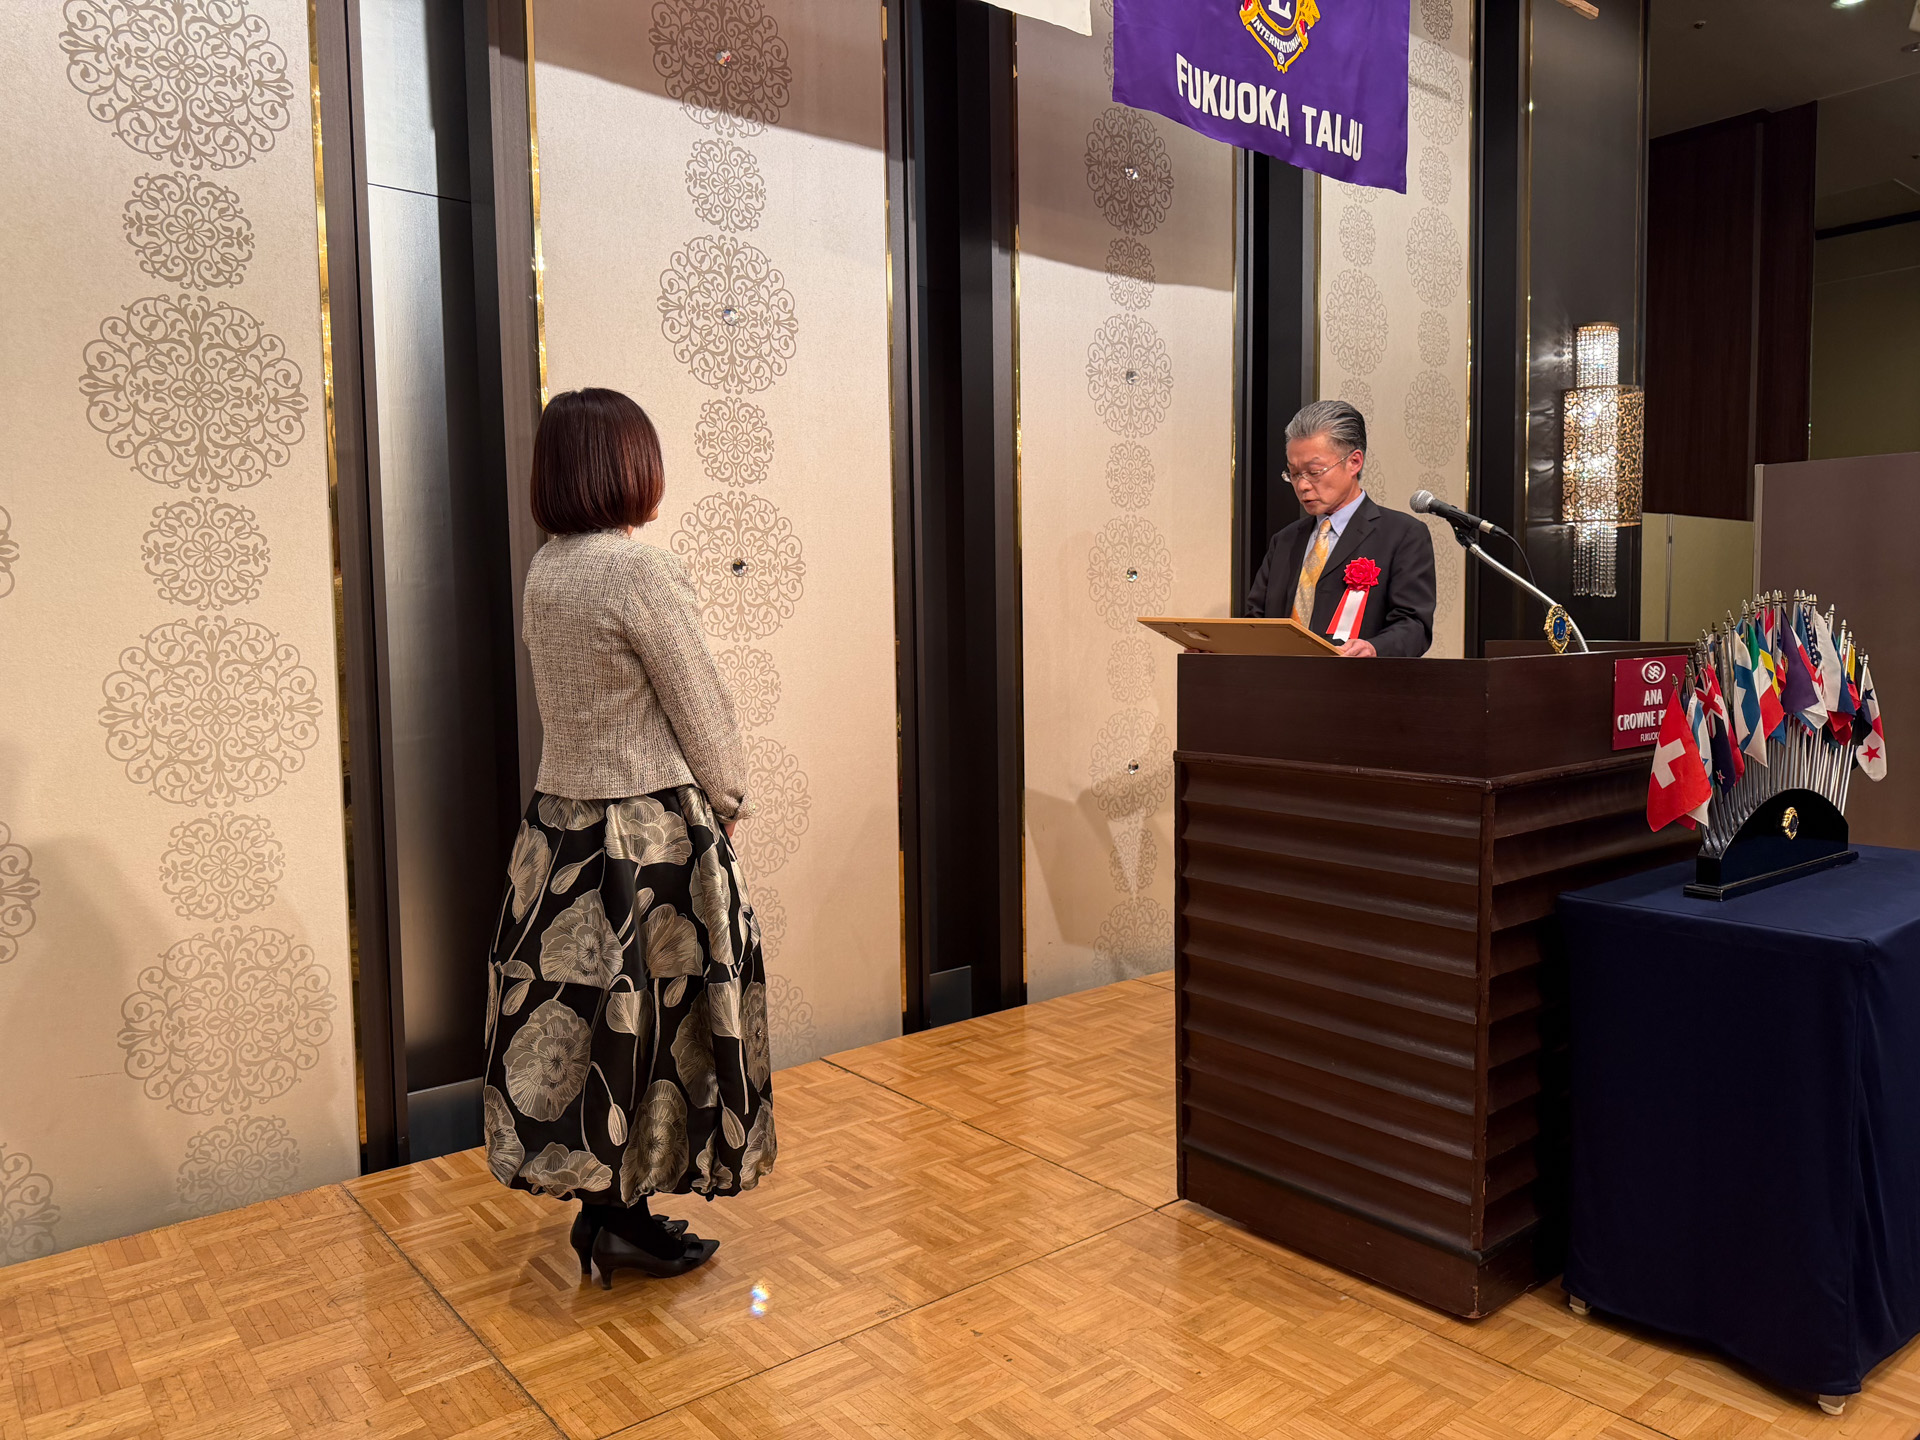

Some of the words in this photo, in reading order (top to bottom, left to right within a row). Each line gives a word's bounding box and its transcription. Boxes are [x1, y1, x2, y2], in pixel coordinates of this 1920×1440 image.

[1251, 16, 1301, 53] INTERNATIONAL
[1176, 53, 1290, 138] FUKUOKA
[1301, 104, 1364, 162] TAIJU
[1643, 689, 1663, 706] ANA
[1617, 711, 1656, 731] CROWNE
[1658, 709, 1667, 726] P
[1640, 731, 1660, 742] FUKUOK
